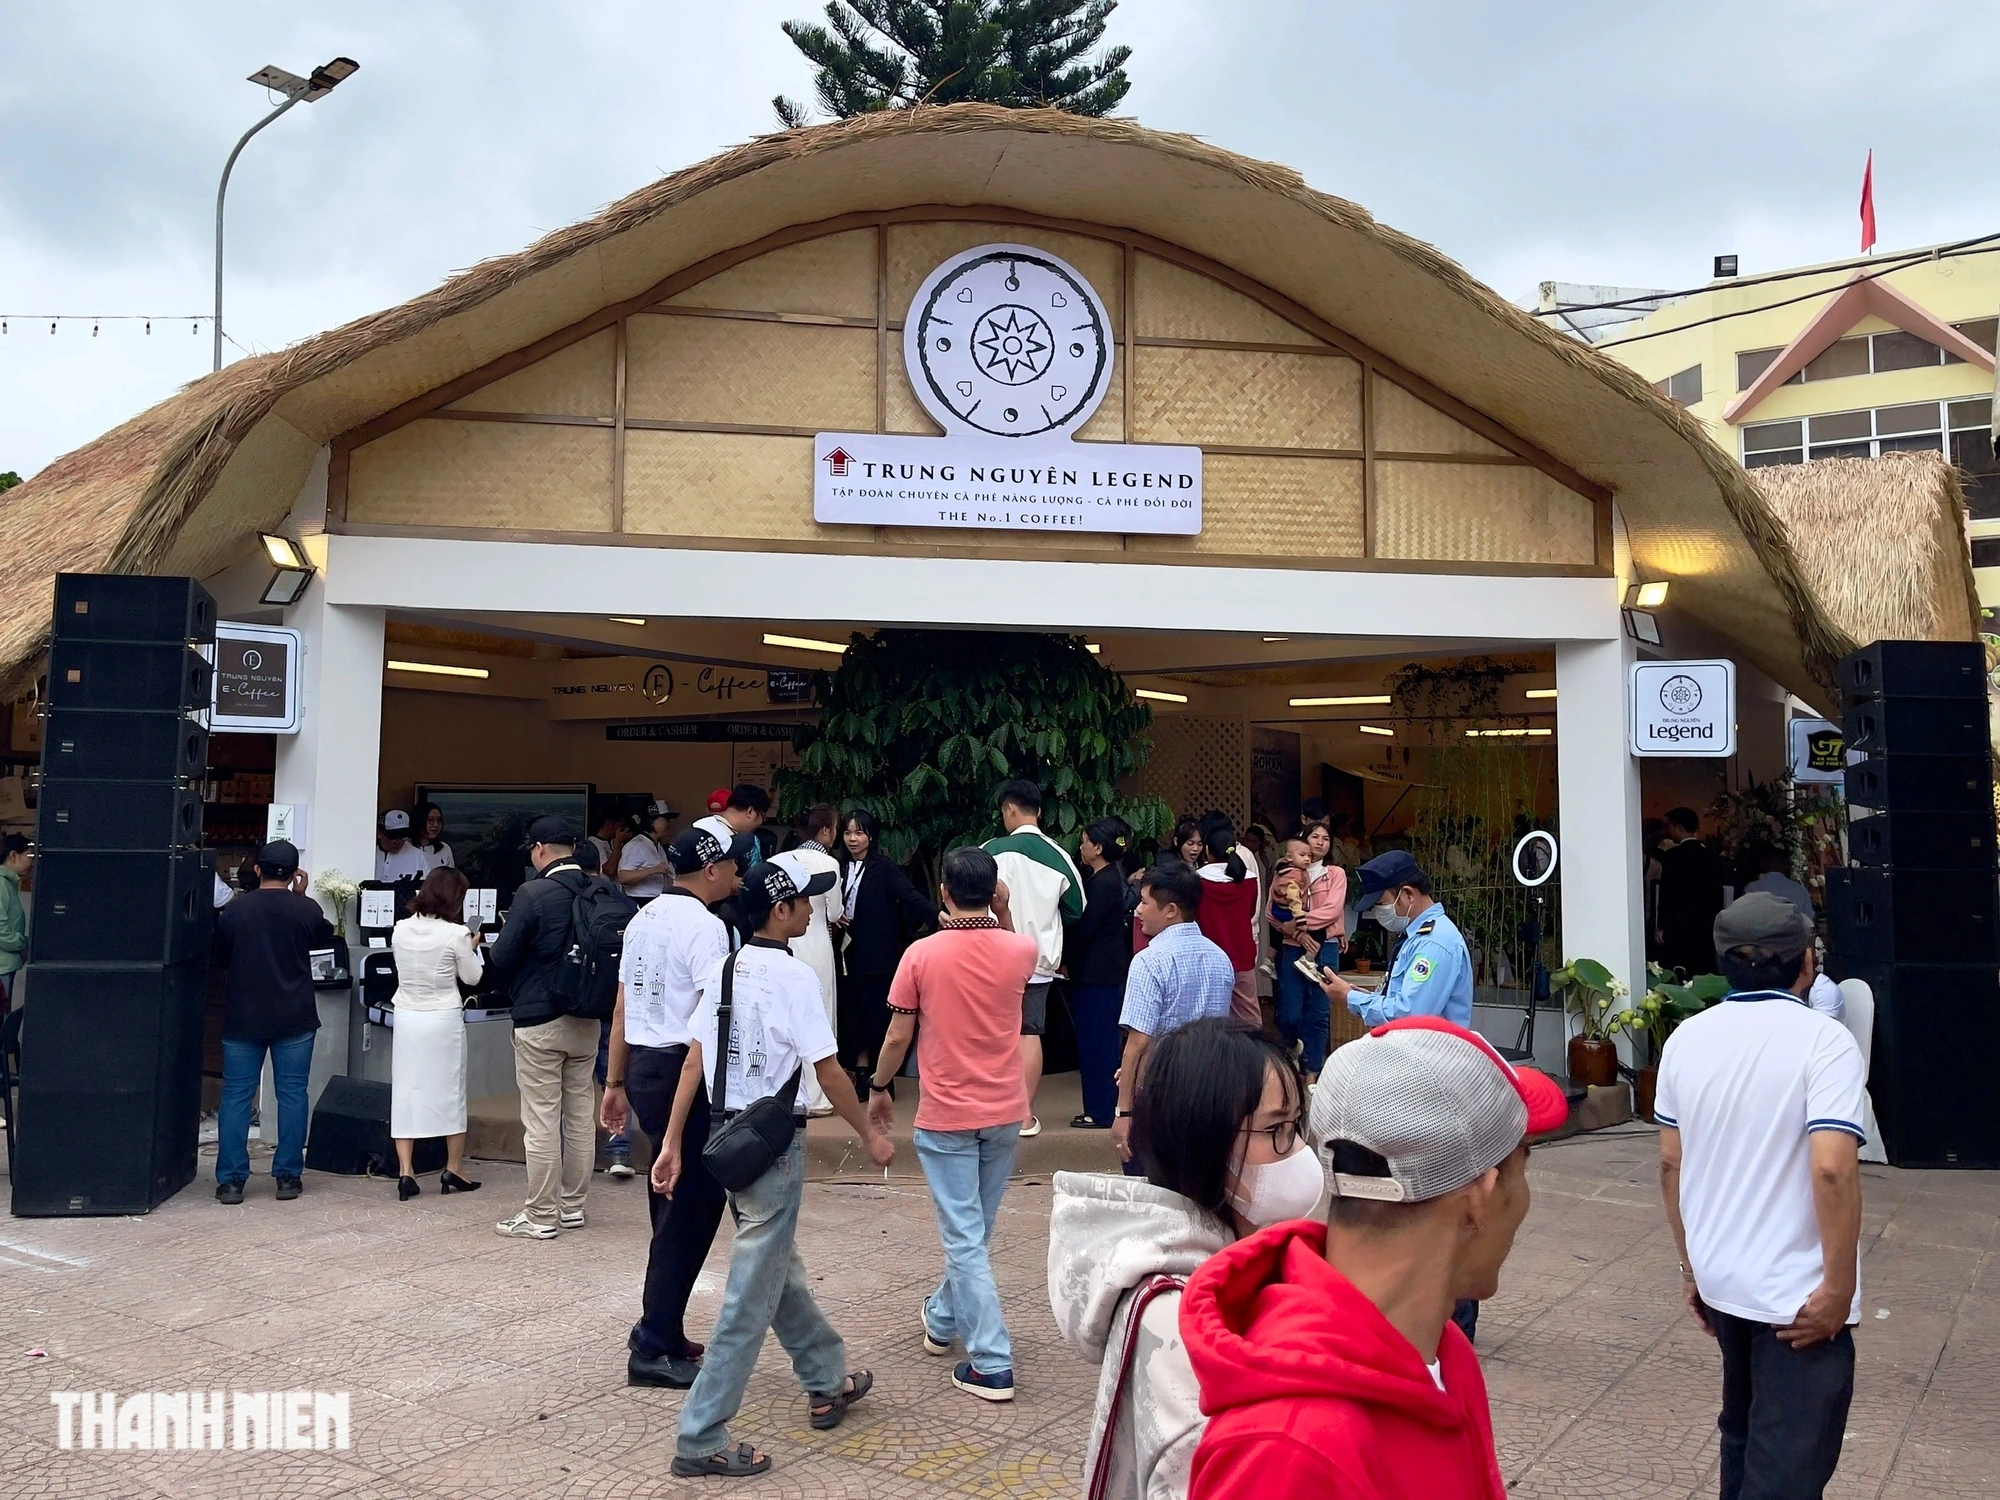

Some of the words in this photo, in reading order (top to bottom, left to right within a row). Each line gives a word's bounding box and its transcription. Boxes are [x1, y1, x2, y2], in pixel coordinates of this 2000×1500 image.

[863, 462, 955, 481] TRUNG
[970, 466, 1077, 485] NGUYÊN
[1092, 471, 1194, 489] LEGEND
[859, 488, 893, 498] ĐOÀN
[899, 490, 949, 500] CHUYÊN
[954, 491, 969, 501] CÀ
[974, 492, 997, 502] PHÊ
[1042, 496, 1083, 506] LƯỢNG
[1097, 497, 1112, 506] CÀ
[1117, 497, 1139, 507] PHÊ
[1171, 498, 1192, 509] ĐỜI
[938, 511, 968, 522] THE
[1020, 514, 1083, 525] COFFEE!
[221, 672, 248, 681] TRUNG
[552, 686, 586, 695] TRUNG
[697, 667, 765, 700] Coffee
[617, 726, 647, 738] ORDER
[649, 726, 657, 736] &
[658, 725, 698, 737] CASHIER
[727, 724, 758, 736] ORDER
[760, 726, 767, 736] &
[1649, 723, 1713, 742] Legend
[1811, 738, 1843, 756] G7
